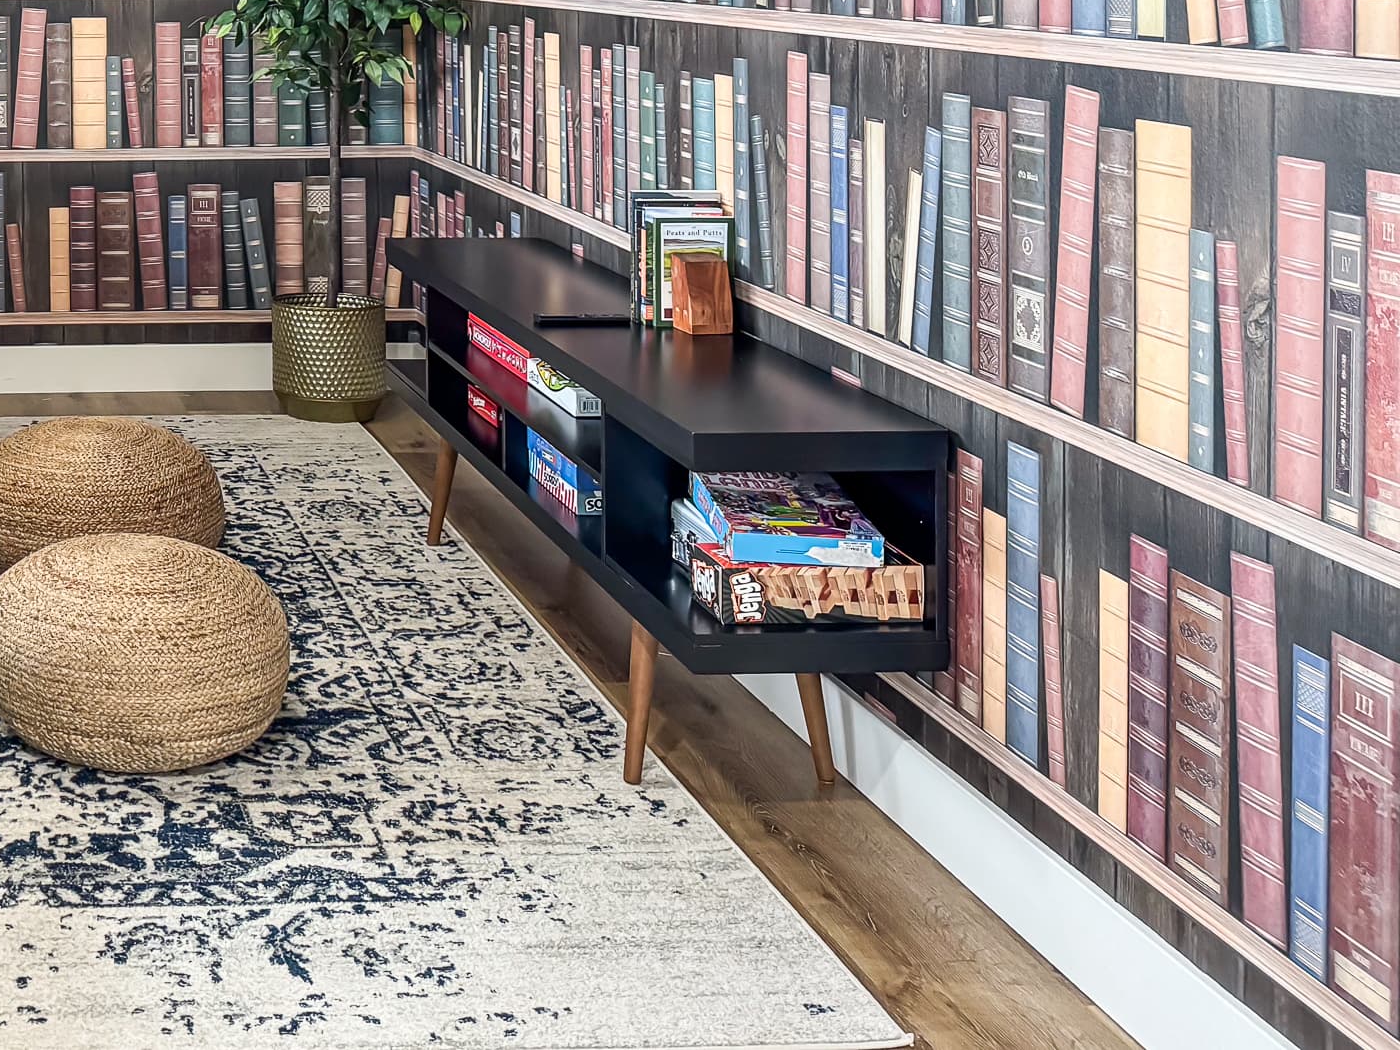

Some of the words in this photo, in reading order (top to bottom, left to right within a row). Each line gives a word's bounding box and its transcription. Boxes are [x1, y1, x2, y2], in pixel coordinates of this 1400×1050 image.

[1341, 254, 1352, 273] IV
[701, 475, 781, 490] LAND
[691, 560, 716, 604] Jenga
[731, 572, 763, 620] Jenga
[1354, 690, 1374, 719] III
